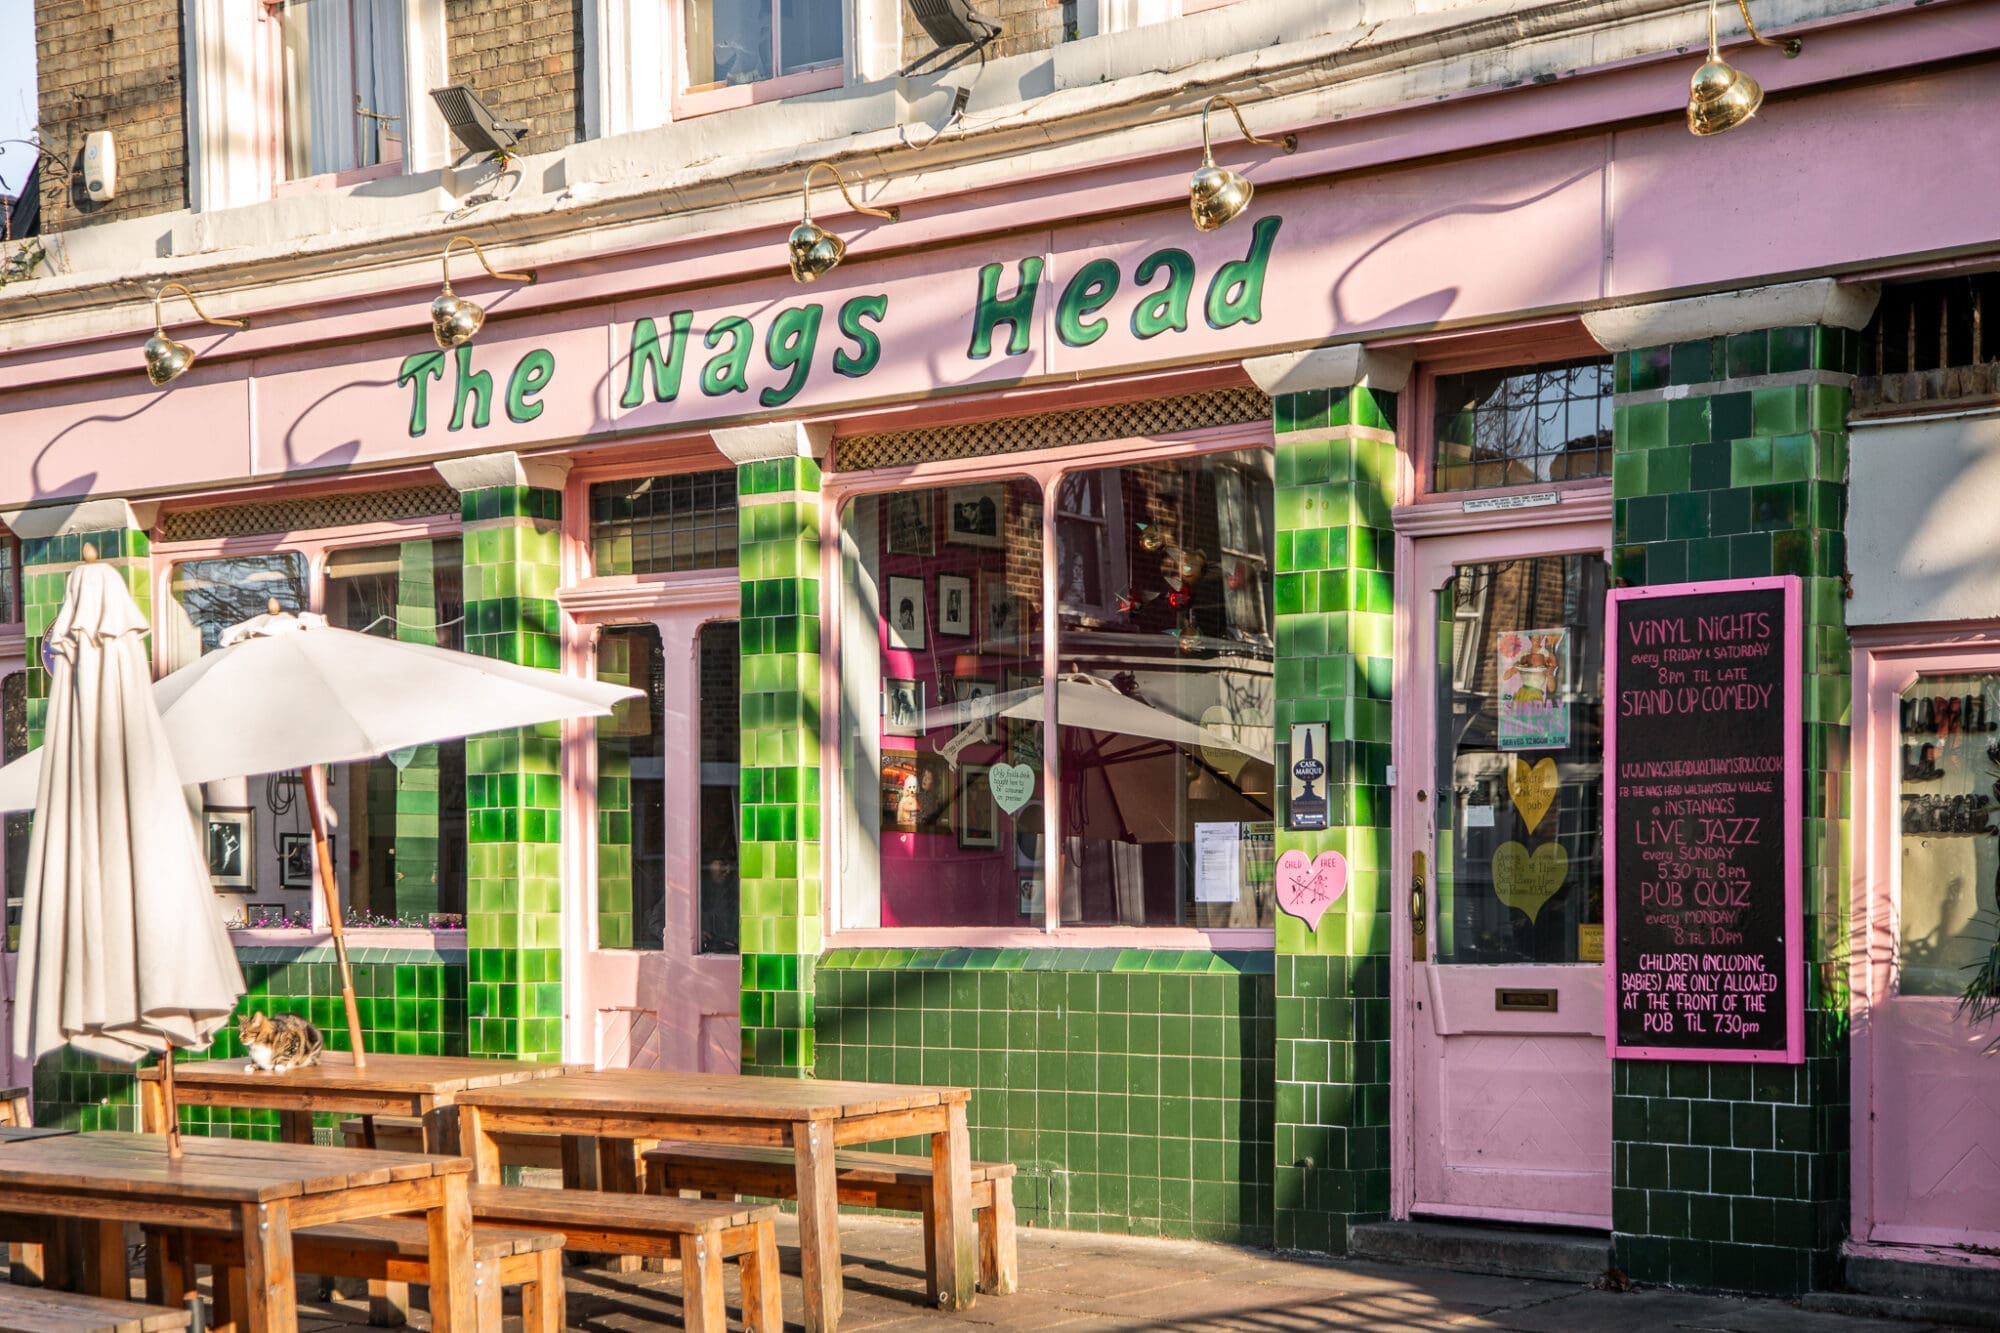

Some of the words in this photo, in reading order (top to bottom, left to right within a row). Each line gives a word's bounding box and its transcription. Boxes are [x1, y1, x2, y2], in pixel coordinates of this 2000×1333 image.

[398, 341, 555, 438] The
[620, 294, 888, 409] Nags
[967, 215, 1282, 360] Head
[1631, 653, 1659, 668] every
[1713, 642, 1770, 659] SATURDAY
[1718, 668, 1748, 681] LATE
[1503, 699, 1566, 716] SUNDAY
[1622, 689, 1673, 716] STAND
[1678, 688, 1699, 713] UP
[1702, 684, 1773, 711] COMEDY
[1503, 717, 1565, 736] ROASTS
[1295, 767, 1322, 776] MARQUE
[1632, 786, 1645, 797] THE
[1646, 785, 1663, 797] NAGS
[1664, 784, 1682, 796] HEAD
[1684, 782, 1737, 795] WALTHAMSTOW
[1696, 818, 1760, 844] JAZZ
[1642, 850, 1673, 864] every
[1679, 847, 1735, 860] SUNDAY
[1641, 881, 1683, 906] PUB
[1645, 913, 1679, 928] every
[1685, 911, 1737, 924] MONDAY
[1674, 927, 1684, 945] 8
[1665, 973, 1687, 991] ARE
[1690, 974, 1720, 991] ONLY
[1723, 974, 1777, 992] ALLOWED
[1623, 992, 1639, 1010] AT
[1646, 993, 1670, 1011] THE
[1676, 993, 1718, 1011] FRONT
[1722, 994, 1738, 1011] OF
[1743, 994, 1767, 1012] THE
[1644, 1013, 1673, 1032] PUB
